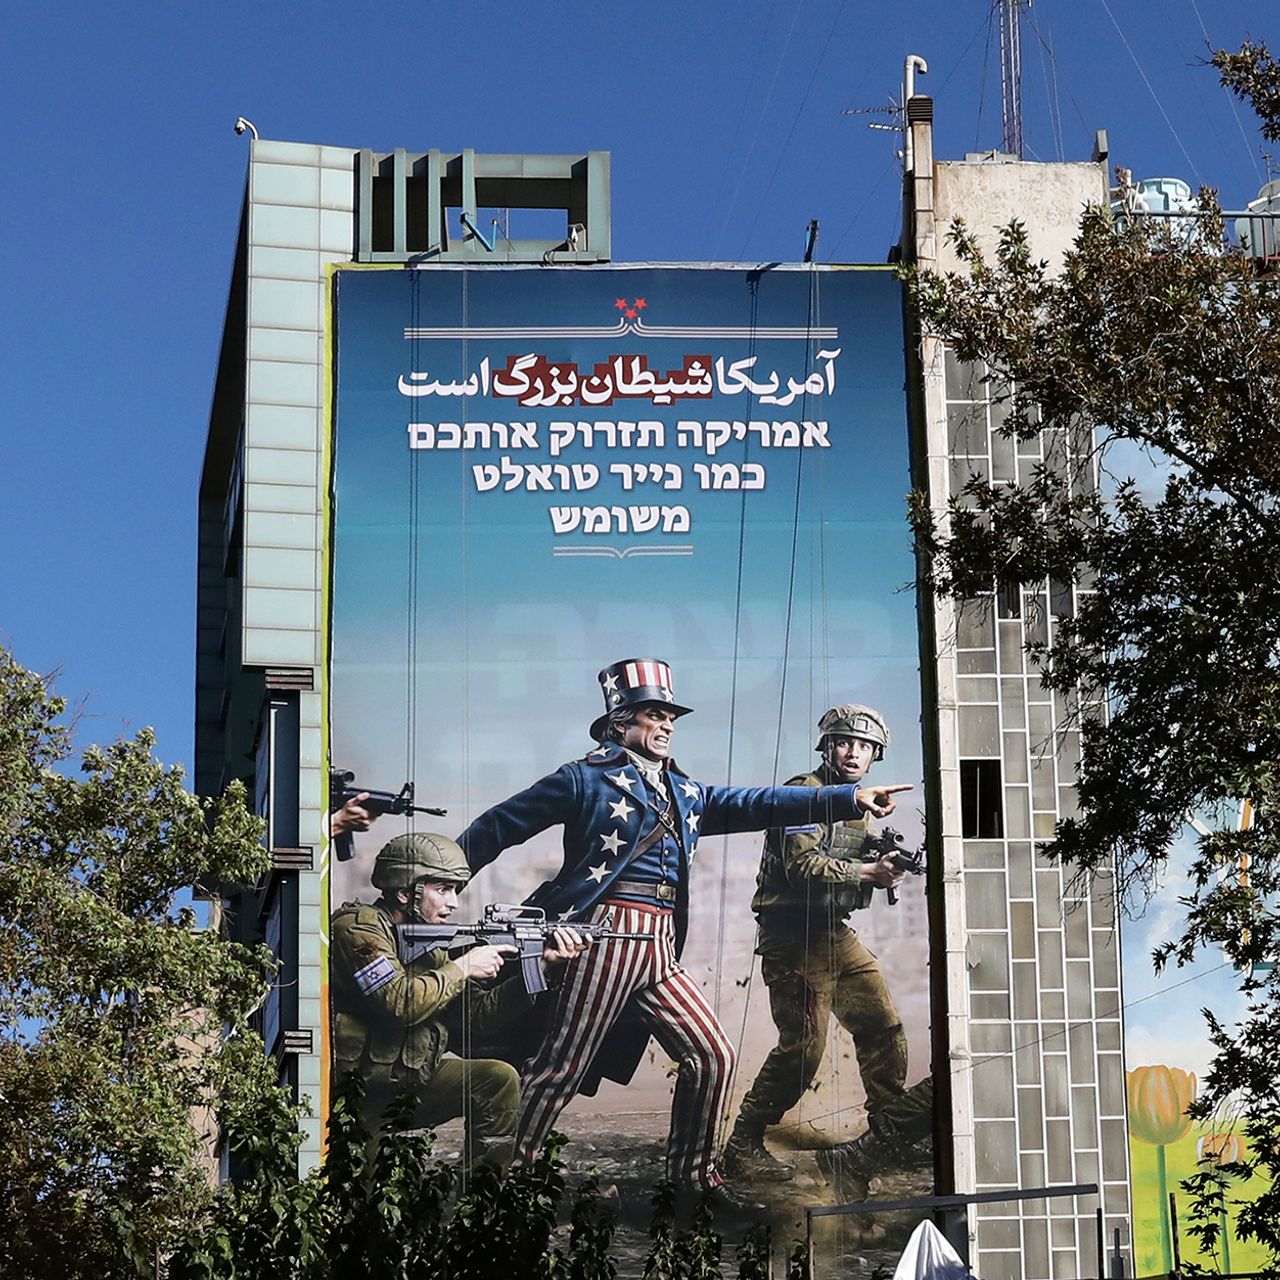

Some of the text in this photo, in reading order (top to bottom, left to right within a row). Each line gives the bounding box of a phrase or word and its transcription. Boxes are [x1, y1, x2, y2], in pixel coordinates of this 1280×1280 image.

[397, 347, 842, 406] آمریکا شیطان بزرگ است
[407, 419, 831, 456] אמריקה תזרוק אותכם
[473, 457, 766, 492] כמו נייר טואלט
[550, 505, 691, 534] משומש
